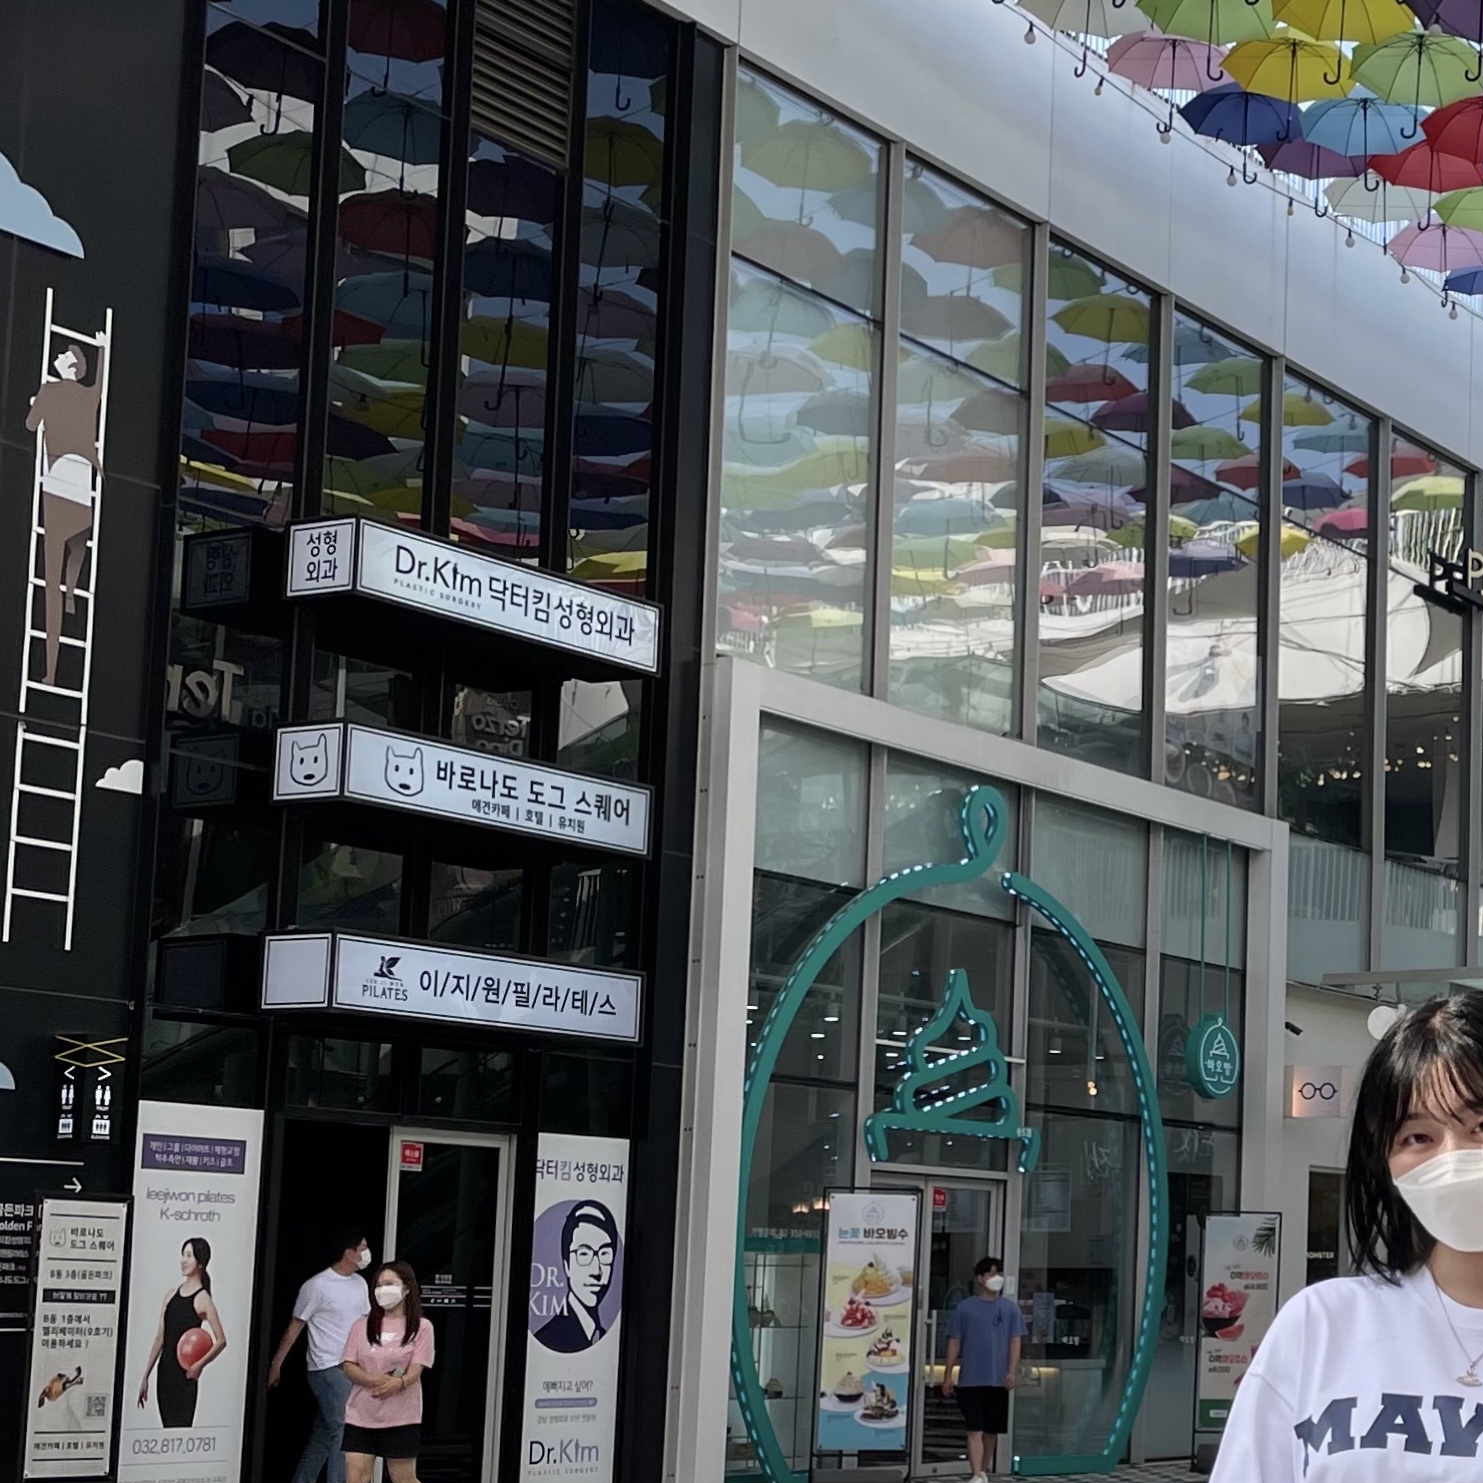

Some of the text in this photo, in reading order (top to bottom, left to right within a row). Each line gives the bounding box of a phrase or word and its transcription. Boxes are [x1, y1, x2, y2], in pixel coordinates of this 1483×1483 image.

[306, 530, 338, 557] 성형
[305, 558, 338, 583] 외과
[394, 577, 435, 597] PLASTIC
[436, 760, 630, 826] 바로나도 도그 스퀘어
[471, 798, 586, 834] 애견카페 호텔 유치원
[361, 986, 408, 1002] PILATES
[420, 969, 617, 1017] 이/지/원/필/라/테/스
[160, 1207, 221, 1222] K-schroth
[70, 1227, 104, 1238] 바로나도
[70, 1239, 87, 1250] 도그
[132, 1436, 217, 1455] 032.817.0781
